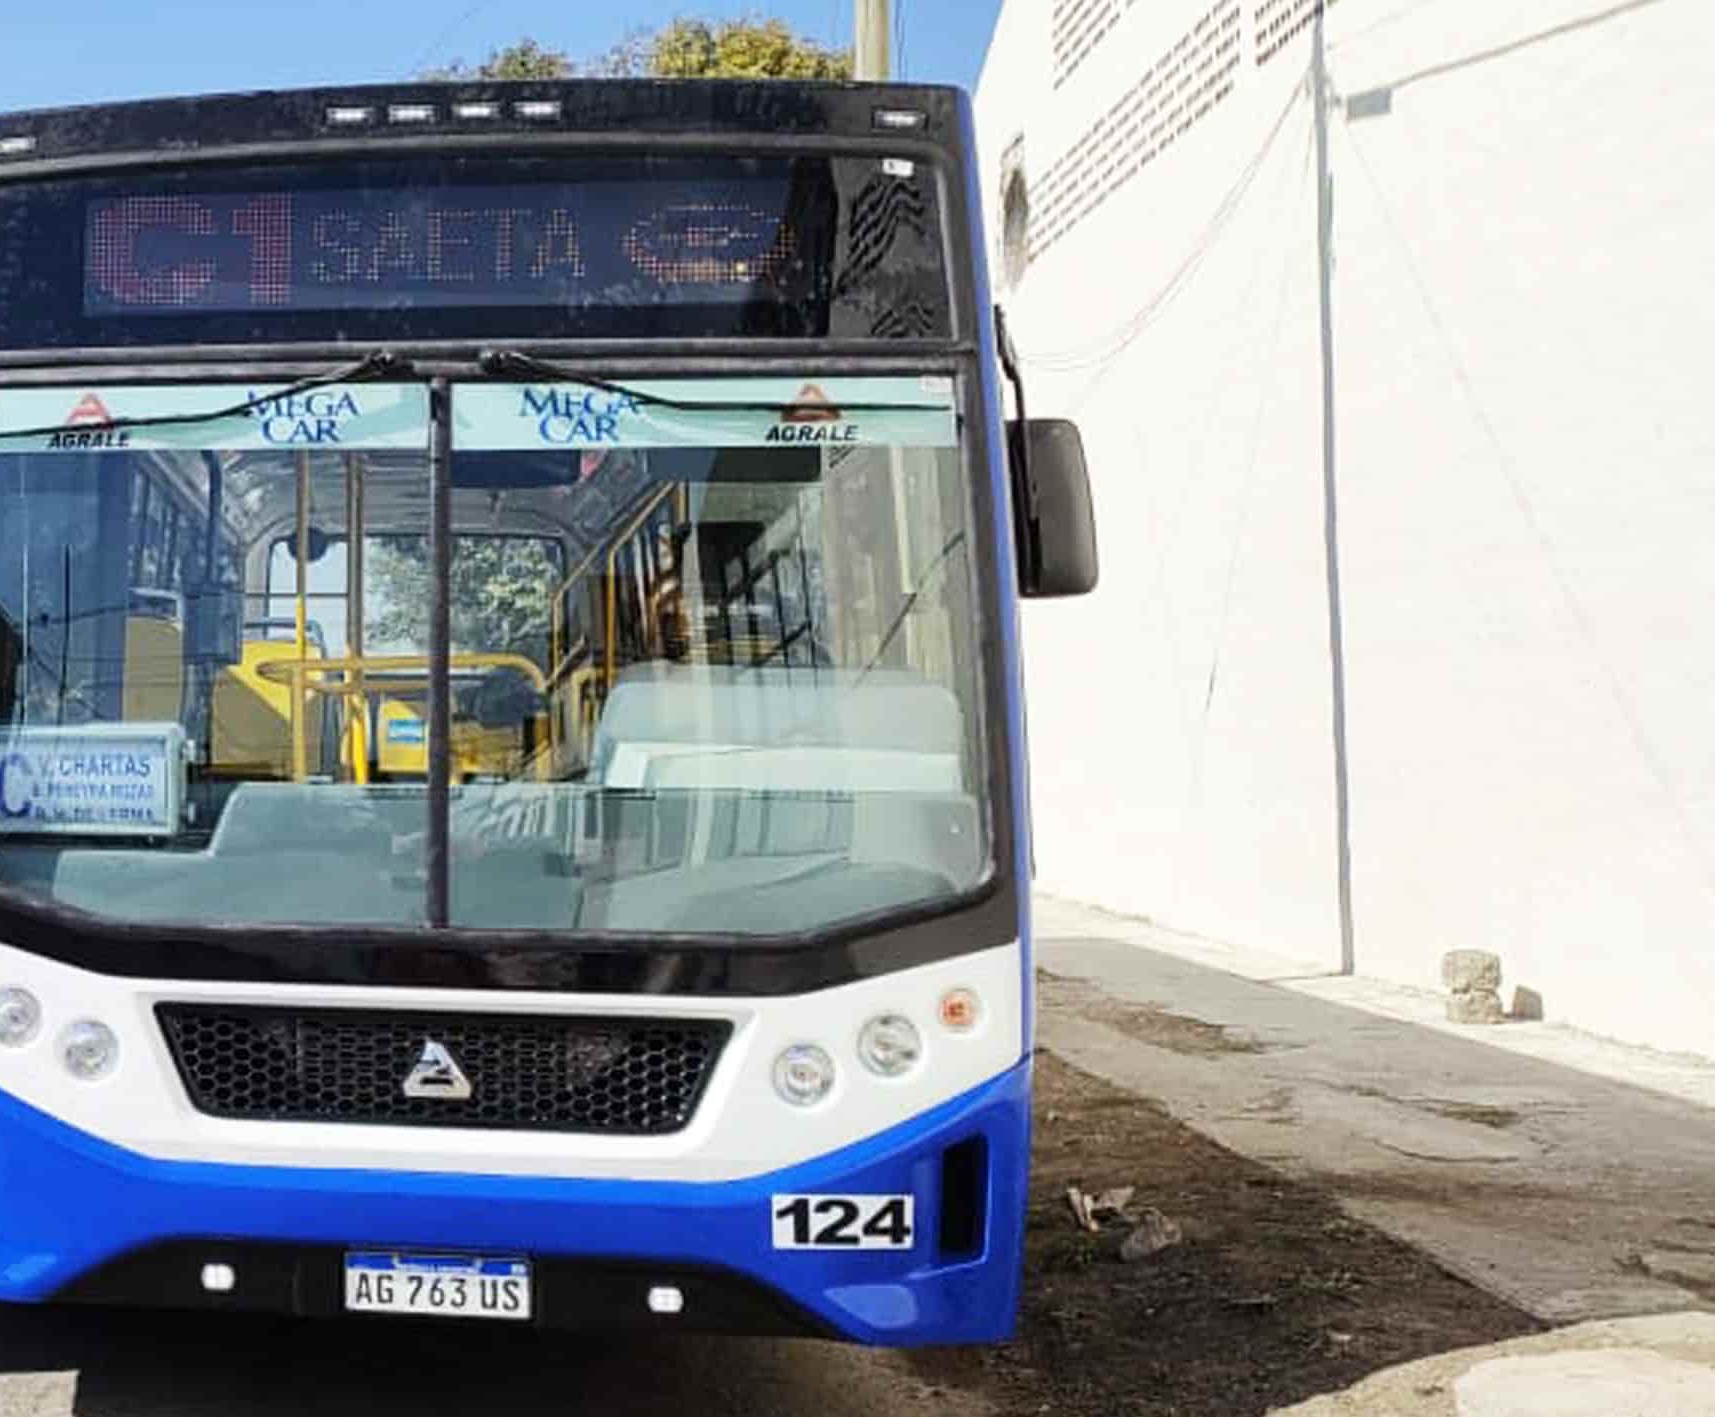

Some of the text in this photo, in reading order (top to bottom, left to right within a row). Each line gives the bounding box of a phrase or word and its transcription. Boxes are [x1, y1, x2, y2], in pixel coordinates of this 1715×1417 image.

[92, 195, 586, 304] C1 SAETA
[518, 387, 643, 418] MEGA
[46, 430, 130, 450] AGRALE
[261, 419, 340, 445] CAR
[539, 415, 621, 444] CAR
[765, 424, 860, 443] AGRALE
[58, 752, 151, 778] CHARTAS
[775, 1198, 912, 1245] 124
[355, 1272, 520, 1311] AG 763 US
